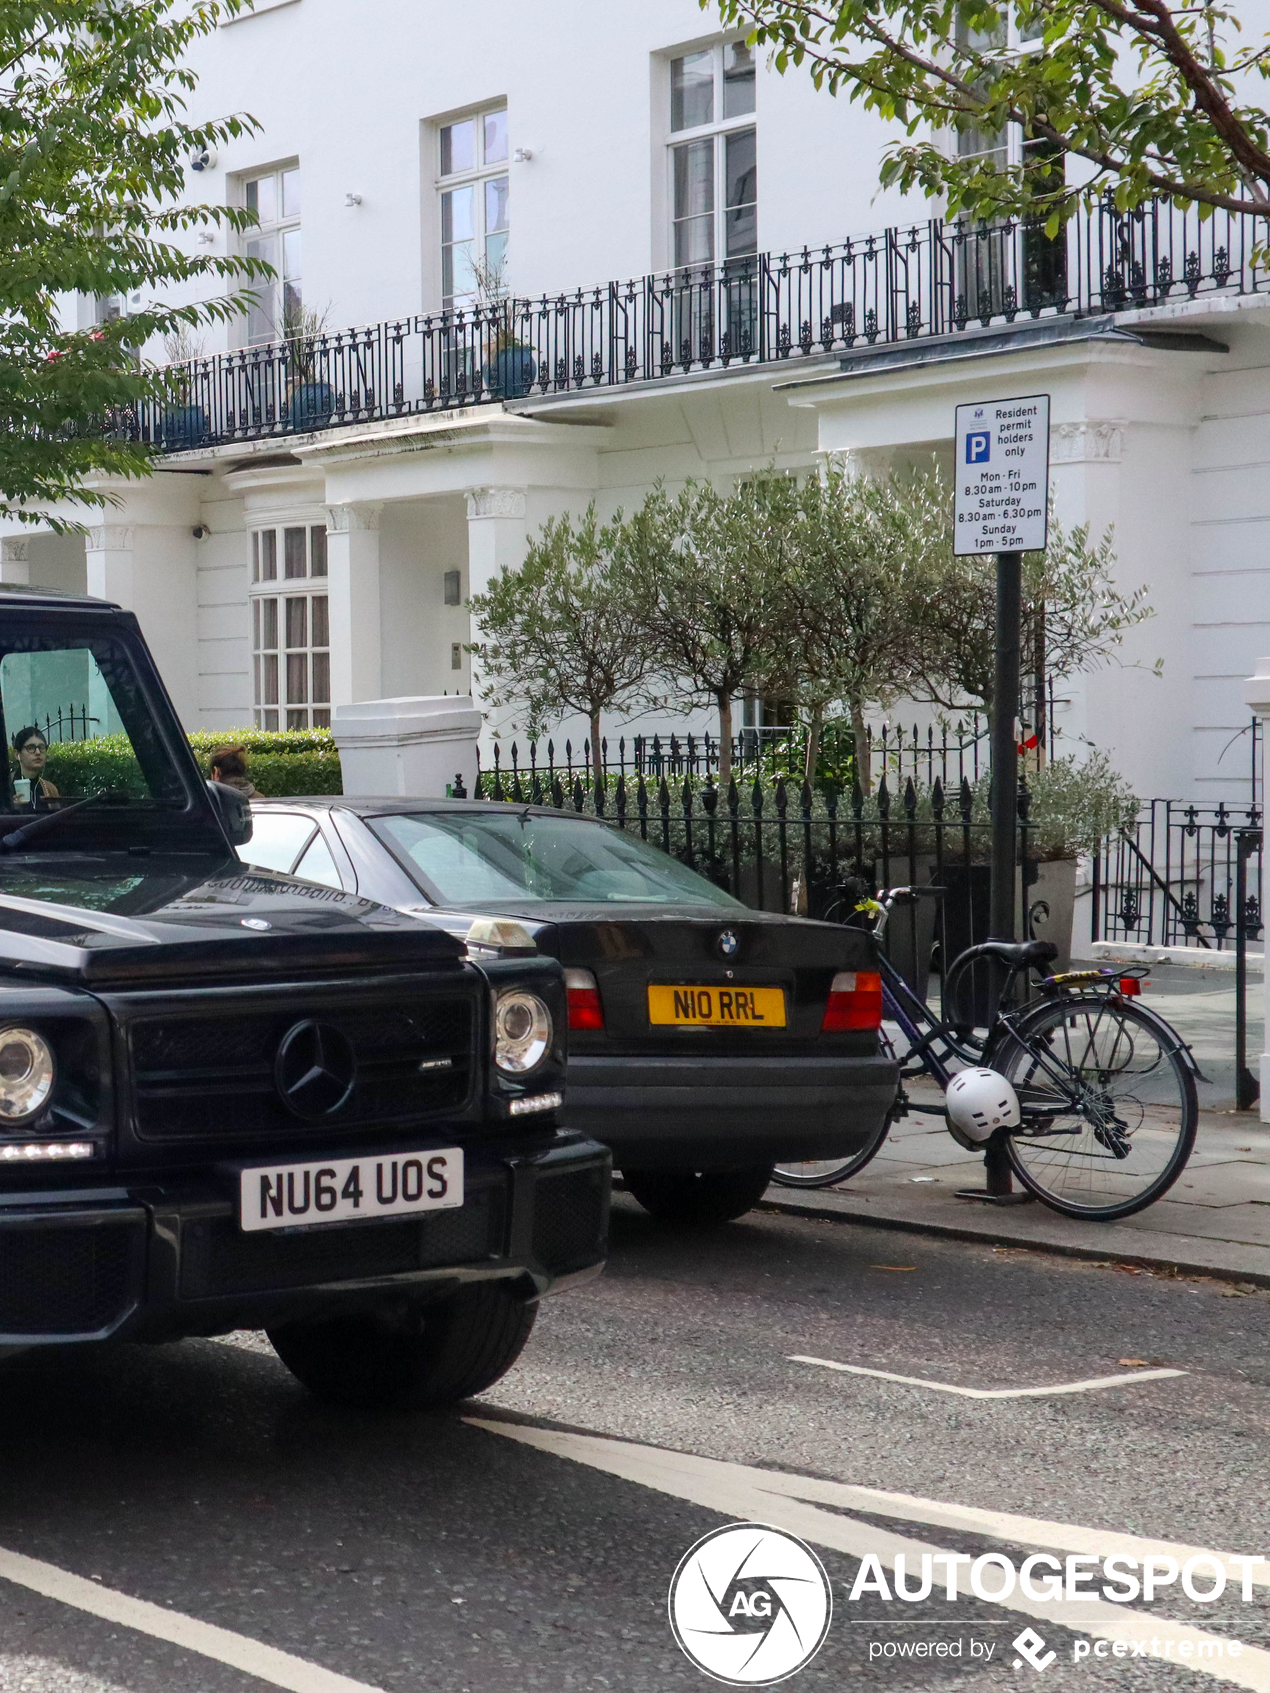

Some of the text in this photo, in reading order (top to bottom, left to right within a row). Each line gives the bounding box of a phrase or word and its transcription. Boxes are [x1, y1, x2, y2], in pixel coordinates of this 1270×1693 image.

[996, 405, 1037, 419] Resident
[1000, 420, 1031, 433] permit
[997, 433, 1033, 444] holders
[971, 436, 986, 461] P
[1005, 446, 1025, 457] only
[980, 472, 1000, 482] Mon
[1008, 469, 1020, 479] Fri
[1009, 482, 1020, 491] 10
[979, 496, 1021, 508] Saturday
[982, 524, 1017, 535] Sunday
[719, 991, 765, 1020] RRL
[259, 1156, 448, 1219] NU64 UOS
